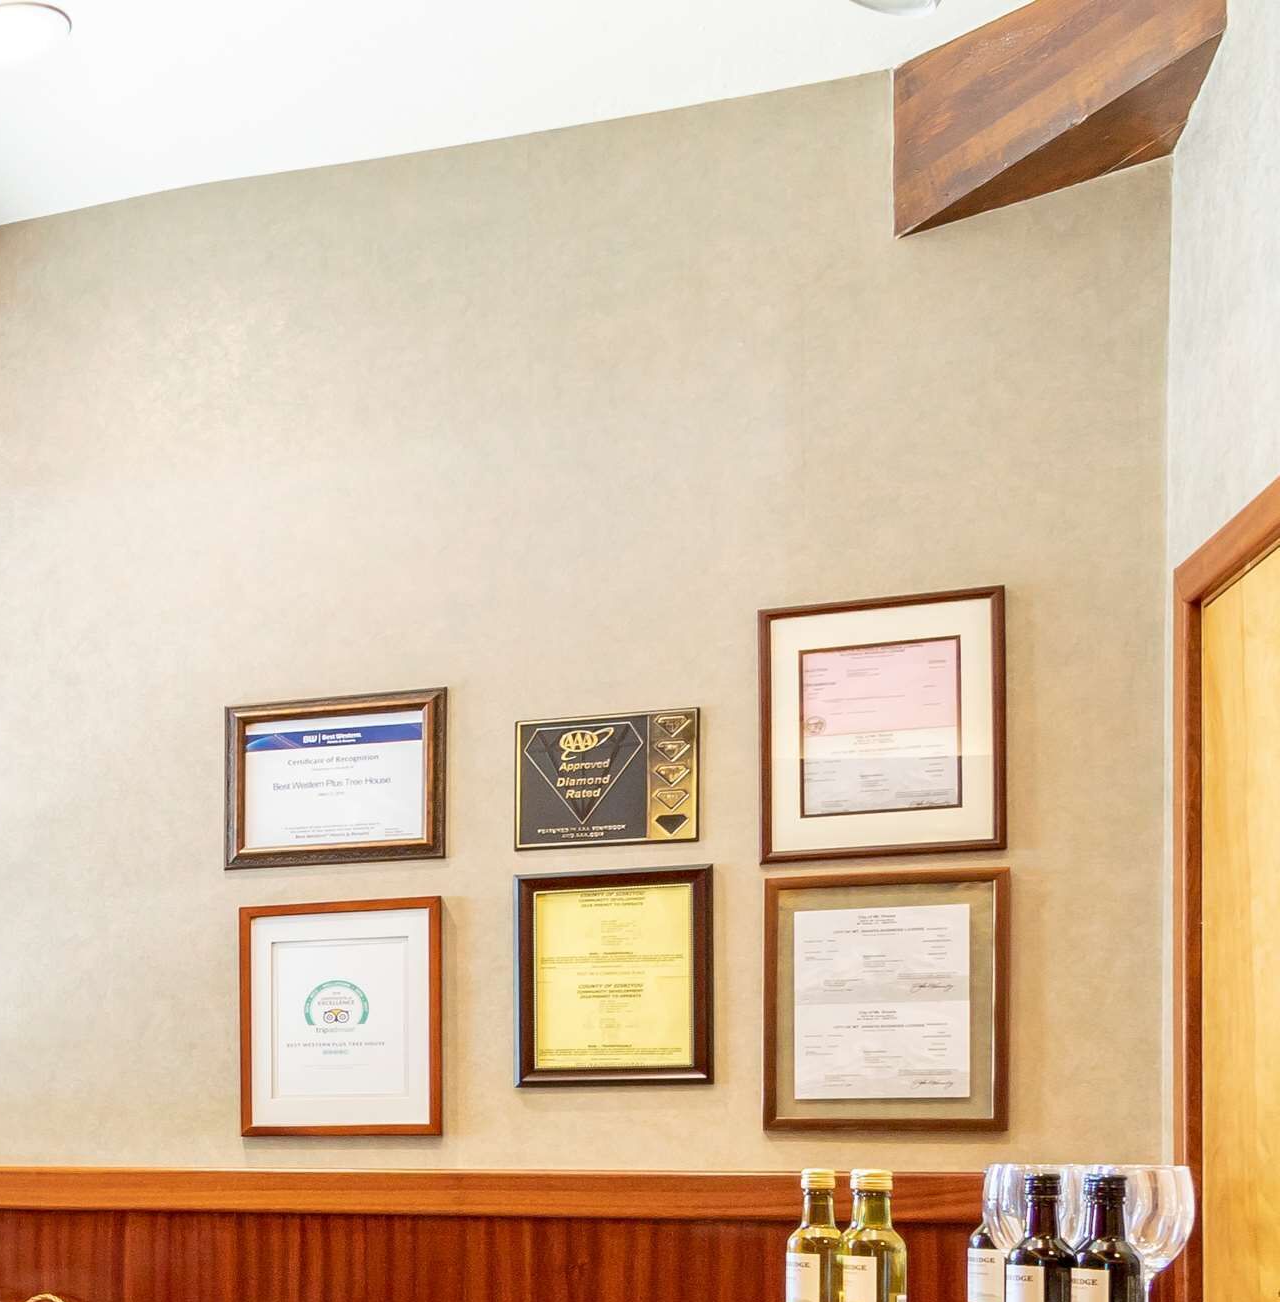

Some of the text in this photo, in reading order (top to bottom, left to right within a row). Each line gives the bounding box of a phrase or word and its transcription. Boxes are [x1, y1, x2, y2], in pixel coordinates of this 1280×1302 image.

[302, 735, 318, 744] BW
[562, 732, 593, 749] AAA
[287, 753, 380, 767] Certificate of Recognition
[558, 758, 611, 772] Approved
[272, 775, 392, 792] Best Western Plus Tree House
[555, 774, 611, 788] Diamond
[565, 787, 602, 799] Rated
